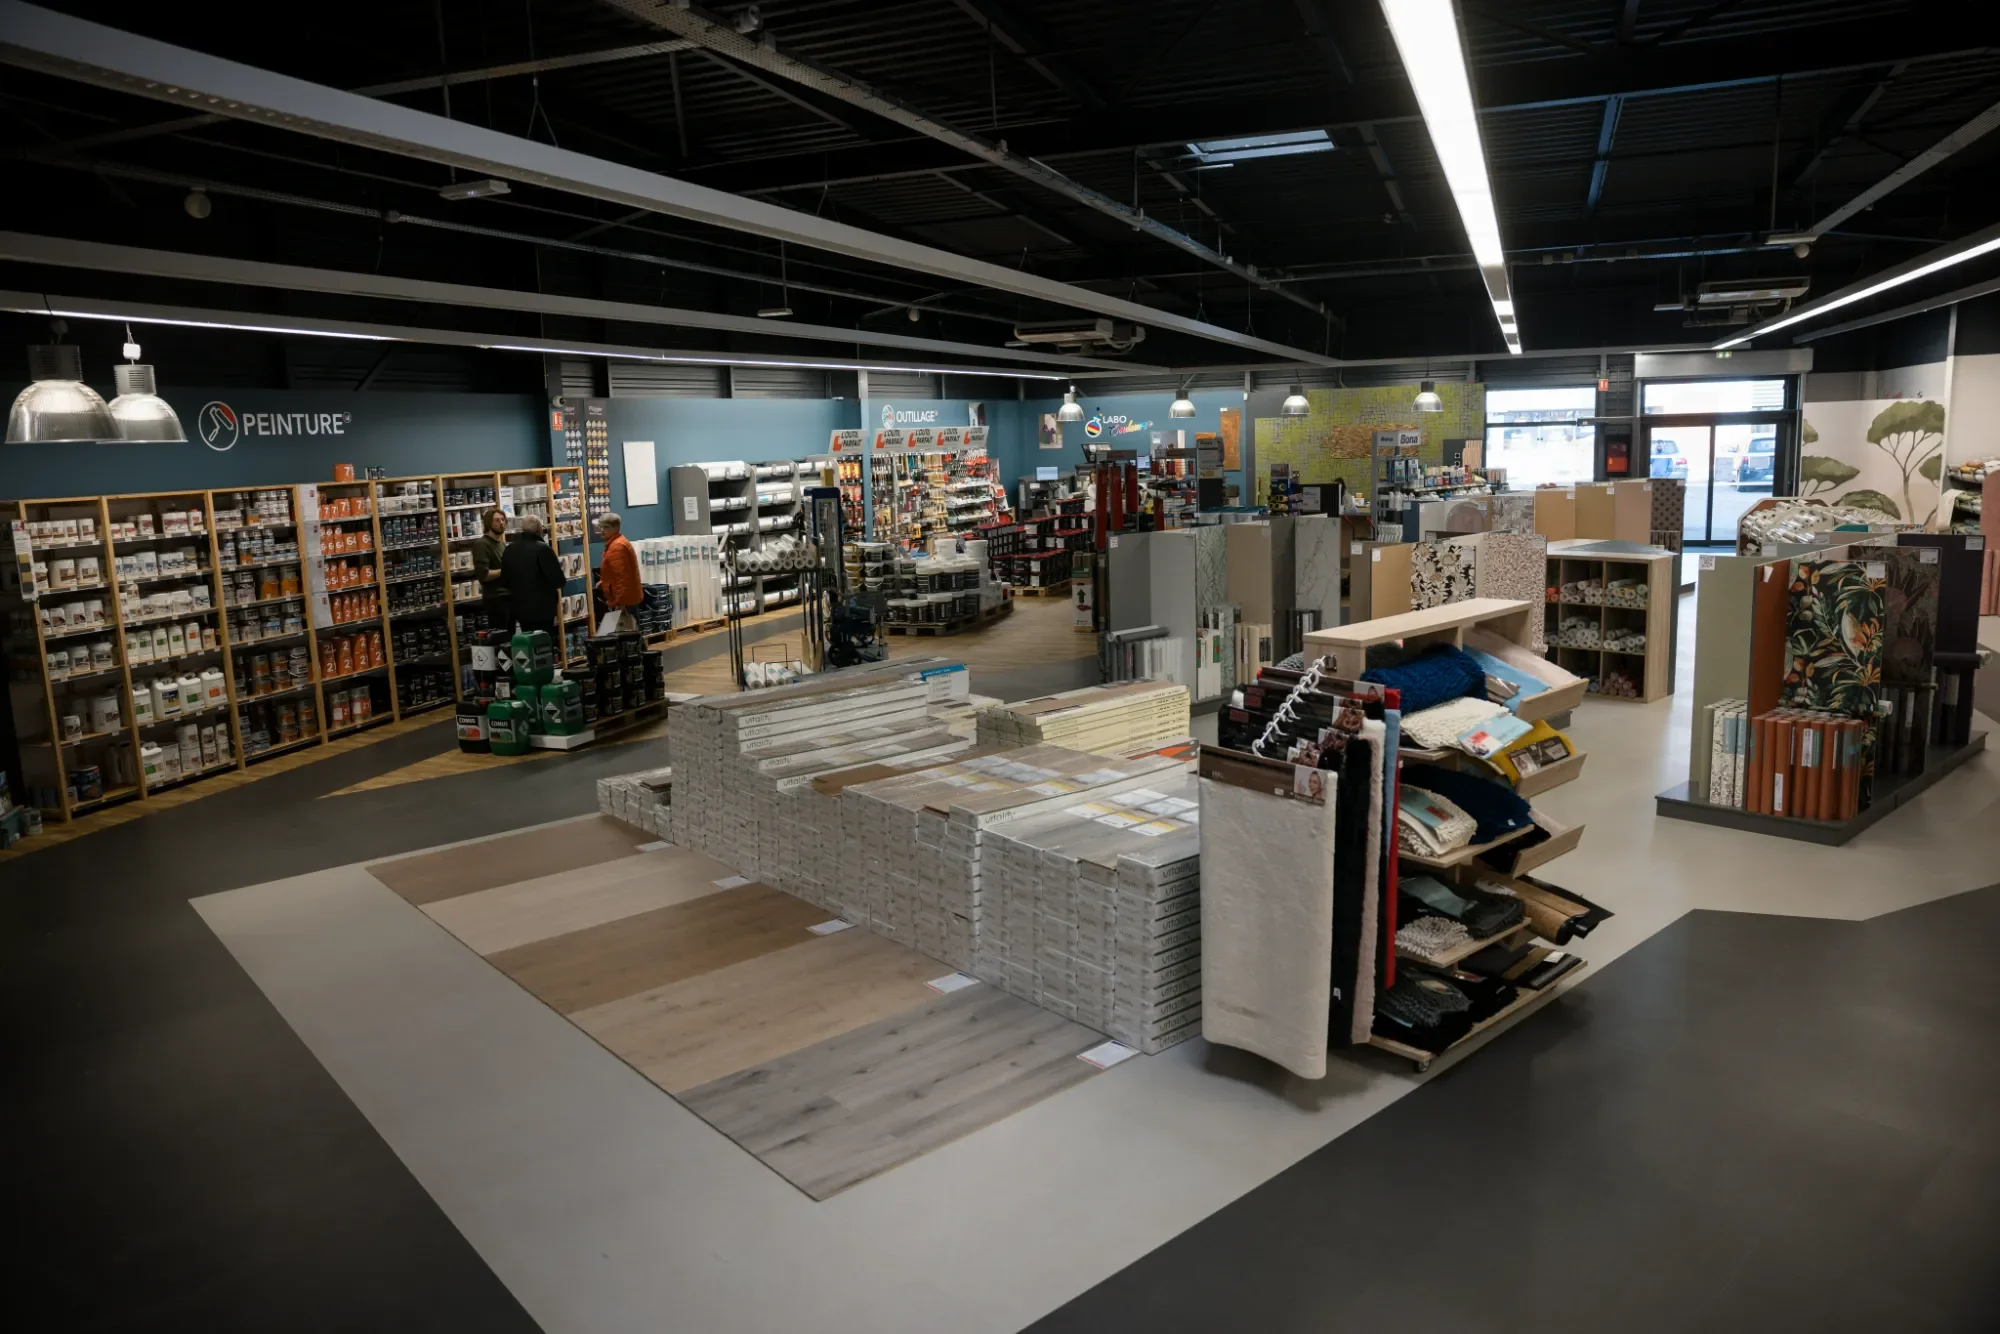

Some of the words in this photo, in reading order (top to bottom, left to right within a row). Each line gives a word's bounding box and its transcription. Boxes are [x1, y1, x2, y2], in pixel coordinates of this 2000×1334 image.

[895, 410, 936, 423] OUTILLAGE
[1102, 415, 1127, 424] LABO
[242, 413, 345, 436] PEINTURE
[1400, 434, 1419, 444] Bona
[744, 714, 773, 725] vitality
[1163, 862, 1194, 878] vitality
